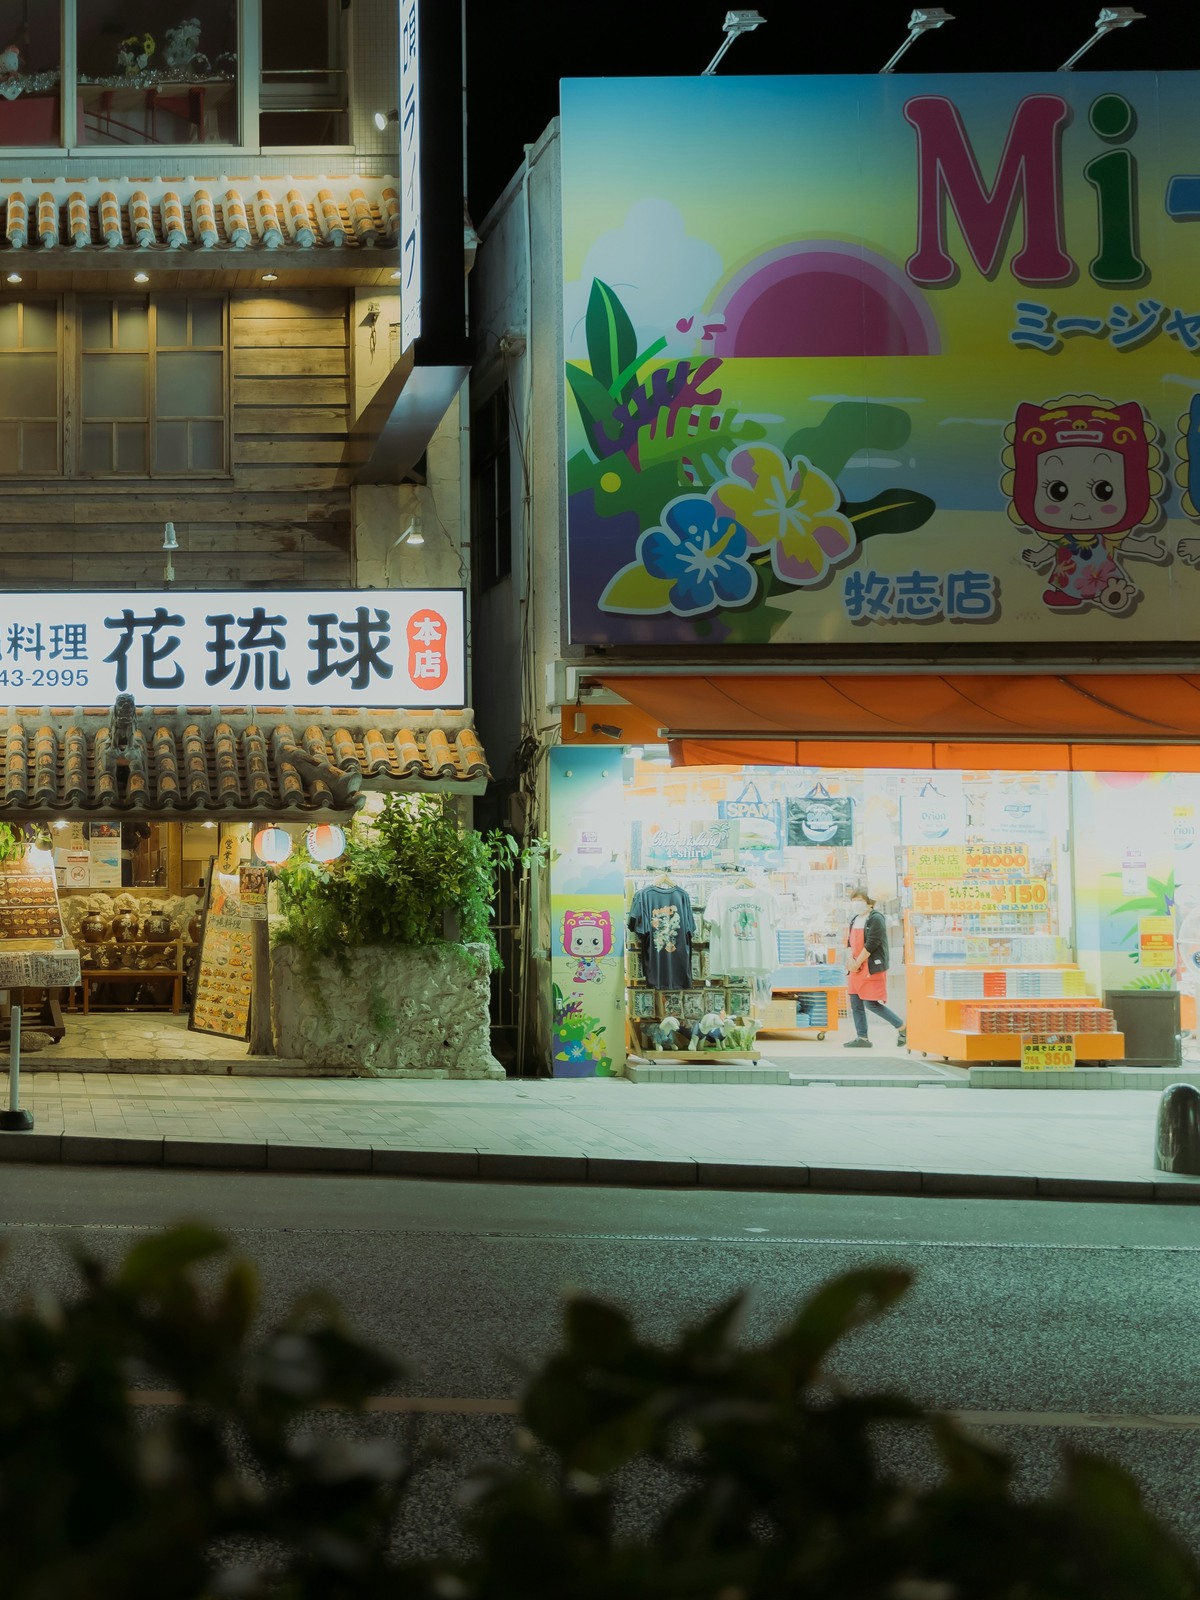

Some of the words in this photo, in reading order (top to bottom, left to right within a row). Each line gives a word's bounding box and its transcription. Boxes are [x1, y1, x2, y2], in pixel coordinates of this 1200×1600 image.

[402, 0, 419, 288] 唄ライブ
[843, 569, 993, 617] 牧志店
[102, 606, 394, 692] 花琉球
[412, 616, 442, 680] 本店
[727, 802, 774, 817] SPAM
[921, 811, 946, 821] Orion
[223, 839, 234, 870] 営業中
[667, 848, 705, 858] T-shirt
[919, 854, 960, 865] 免税店
[966, 855, 1026, 867] ¥1000
[991, 884, 1046, 903] ¥150
